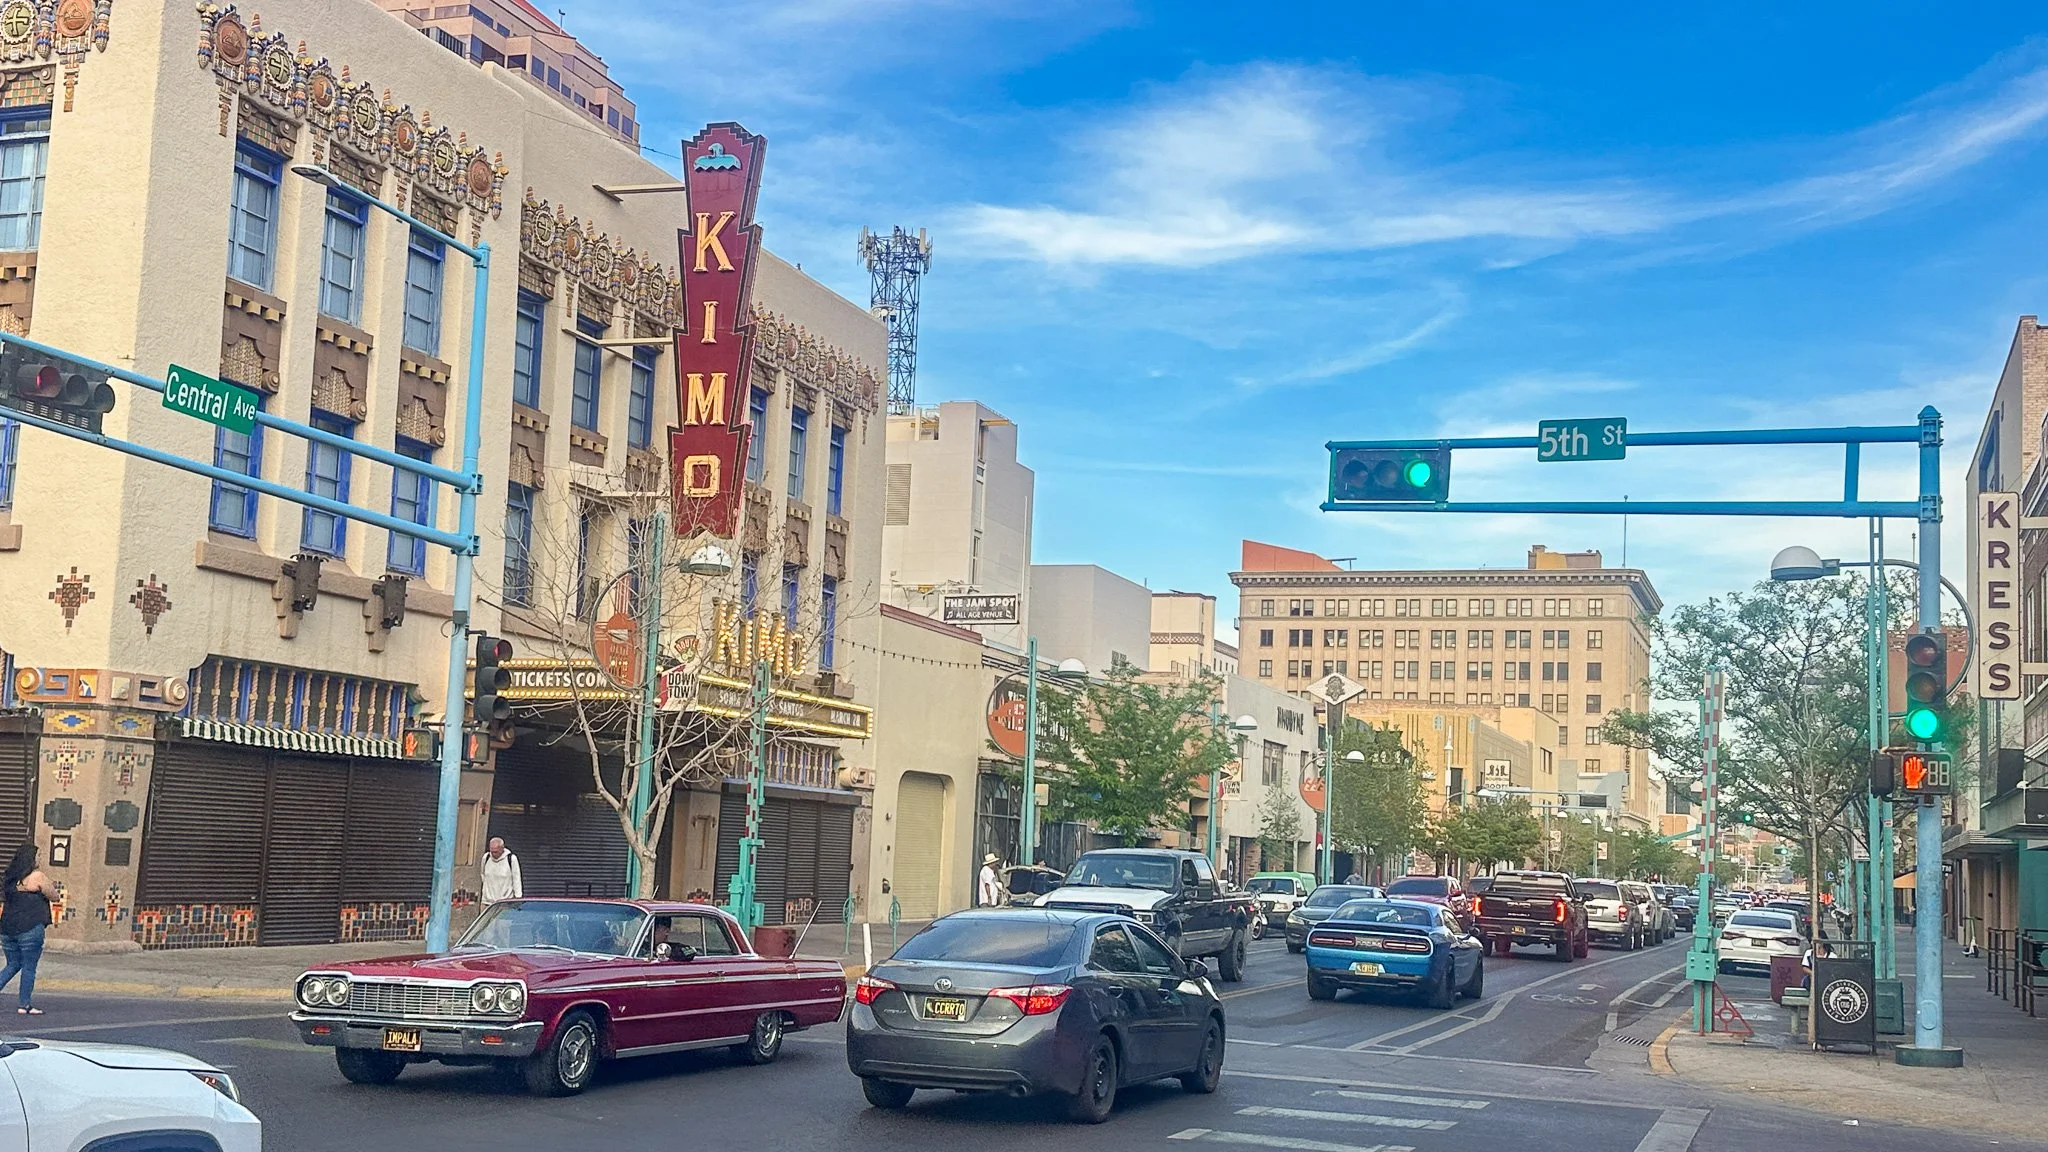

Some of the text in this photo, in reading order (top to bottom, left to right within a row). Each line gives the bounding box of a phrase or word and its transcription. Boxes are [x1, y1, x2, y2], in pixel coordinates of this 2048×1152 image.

[682, 210, 737, 498] KIMO
[166, 371, 256, 421] Central Ave
[1540, 425, 1623, 457] 5th St
[945, 597, 1015, 608] THE JAM SPOT
[1987, 500, 2011, 691] KRESS
[956, 611, 966, 619] ALL
[968, 611, 980, 619] AGE
[668, 672, 697, 686] DOWN
[779, 699, 804, 717] SANTOS
[830, 709, 851, 725] MARCH
[387, 1031, 417, 1045] IMPALA
